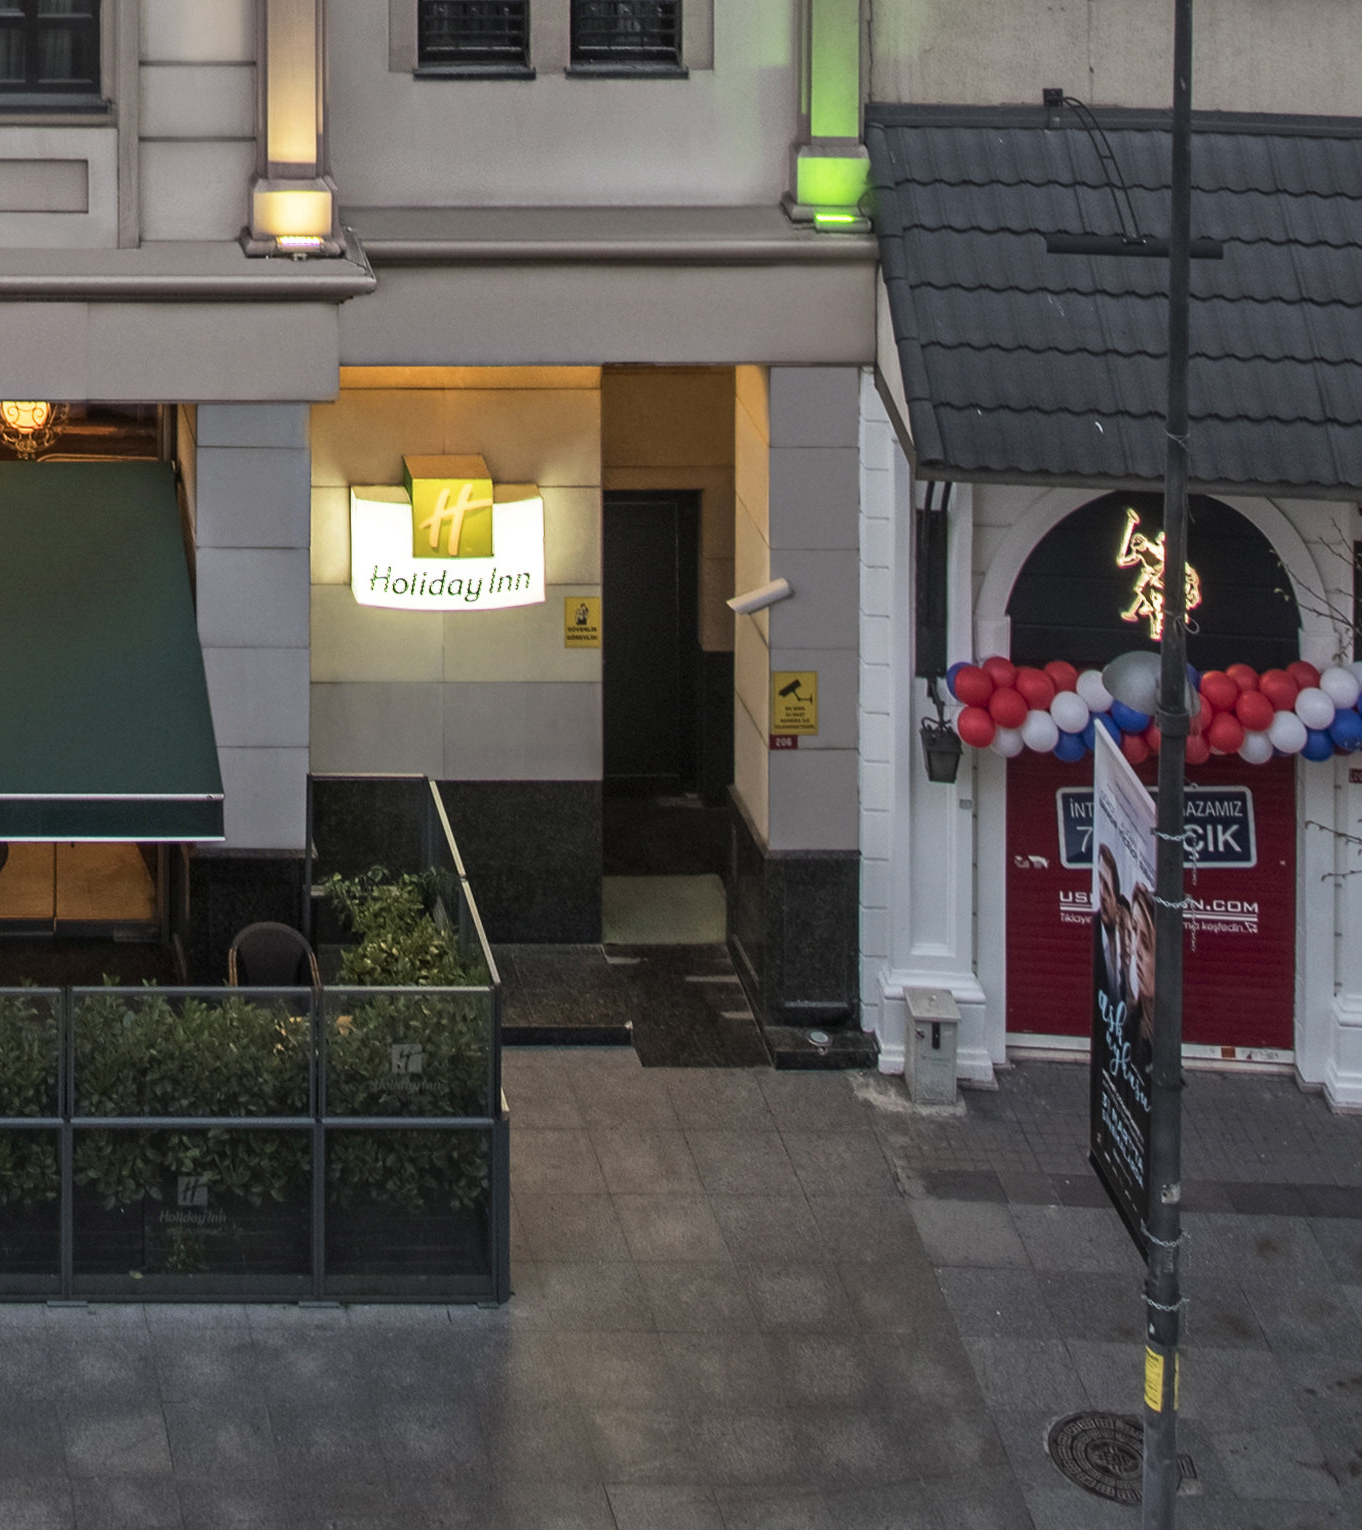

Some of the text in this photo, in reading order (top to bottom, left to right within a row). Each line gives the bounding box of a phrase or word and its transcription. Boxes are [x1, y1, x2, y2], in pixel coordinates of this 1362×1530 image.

[370, 565, 531, 603] Holiday Inn
[1183, 801, 1243, 817] AZAMIZ
